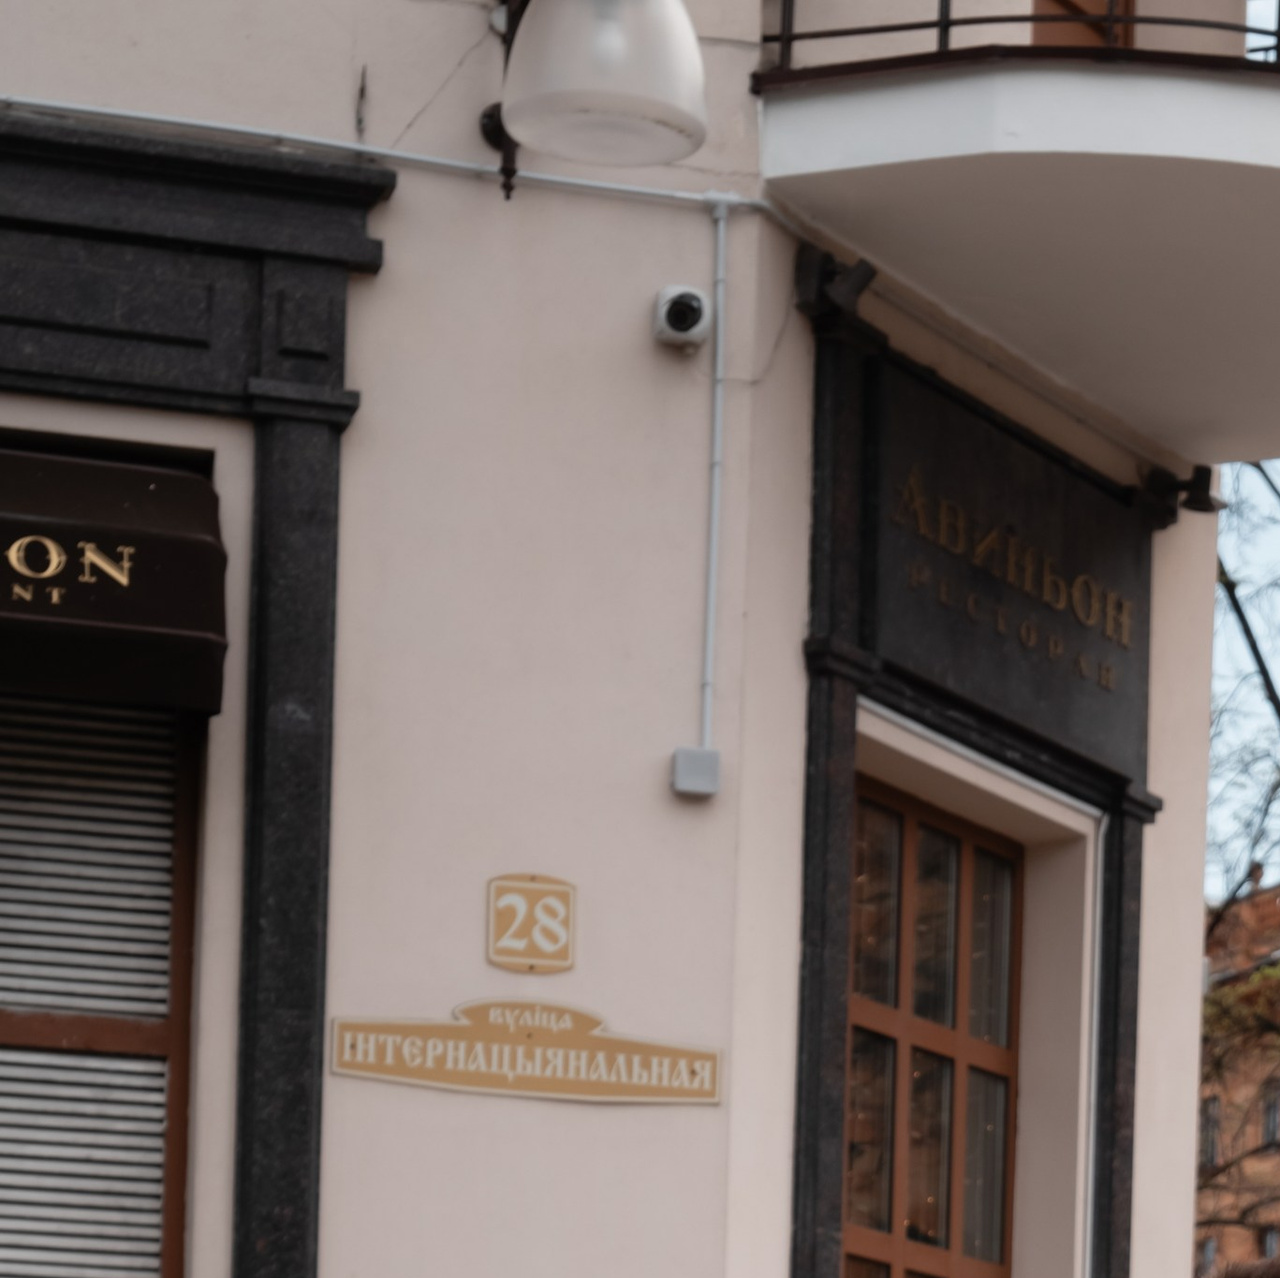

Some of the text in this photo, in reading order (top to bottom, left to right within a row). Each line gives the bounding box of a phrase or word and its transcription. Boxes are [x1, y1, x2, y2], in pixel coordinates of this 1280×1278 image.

[4, 534, 136, 587] ON
[11, 583, 67, 604] NT
[494, 892, 567, 953] 28
[488, 1004, 574, 1032] вуліца
[341, 1030, 712, 1091] ІНТЕРНАЦЫЯНАЛЬНАЯ
